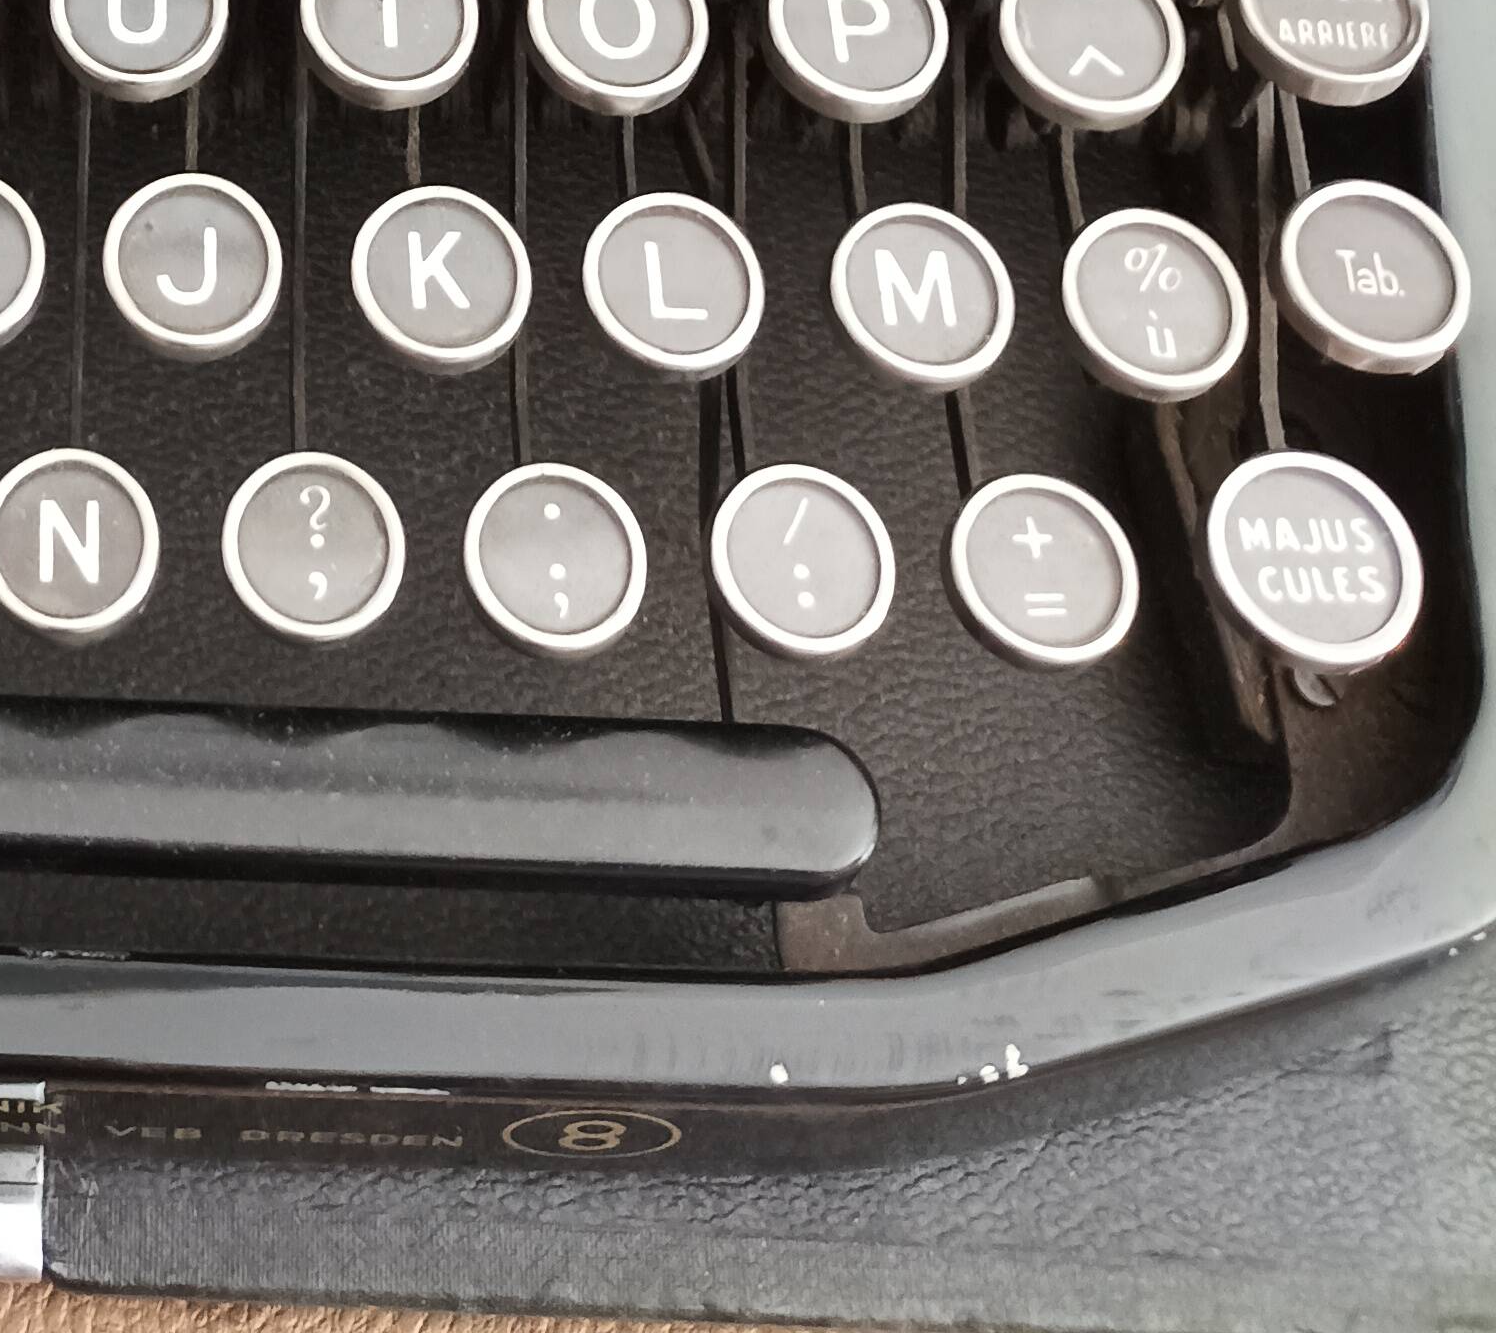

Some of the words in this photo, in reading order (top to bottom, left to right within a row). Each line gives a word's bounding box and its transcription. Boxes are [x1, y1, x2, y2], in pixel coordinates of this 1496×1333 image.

[156, 226, 218, 306] J
[407, 230, 471, 310] K
[643, 240, 709, 321] L
[874, 248, 958, 328] M
[1123, 243, 1183, 293] %
[1335, 249, 1406, 297] Tab.
[299, 484, 331, 550] ?
[783, 497, 809, 545] /
[1011, 516, 1053, 560] +
[1238, 516, 1376, 556] MAJUS
[38, 499, 100, 585] N
[548, 563, 569, 619] ;
[792, 563, 816, 609] :
[1023, 592, 1068, 617] =
[1257, 565, 1387, 605] CULES
[558, 1119, 627, 1151] 8
